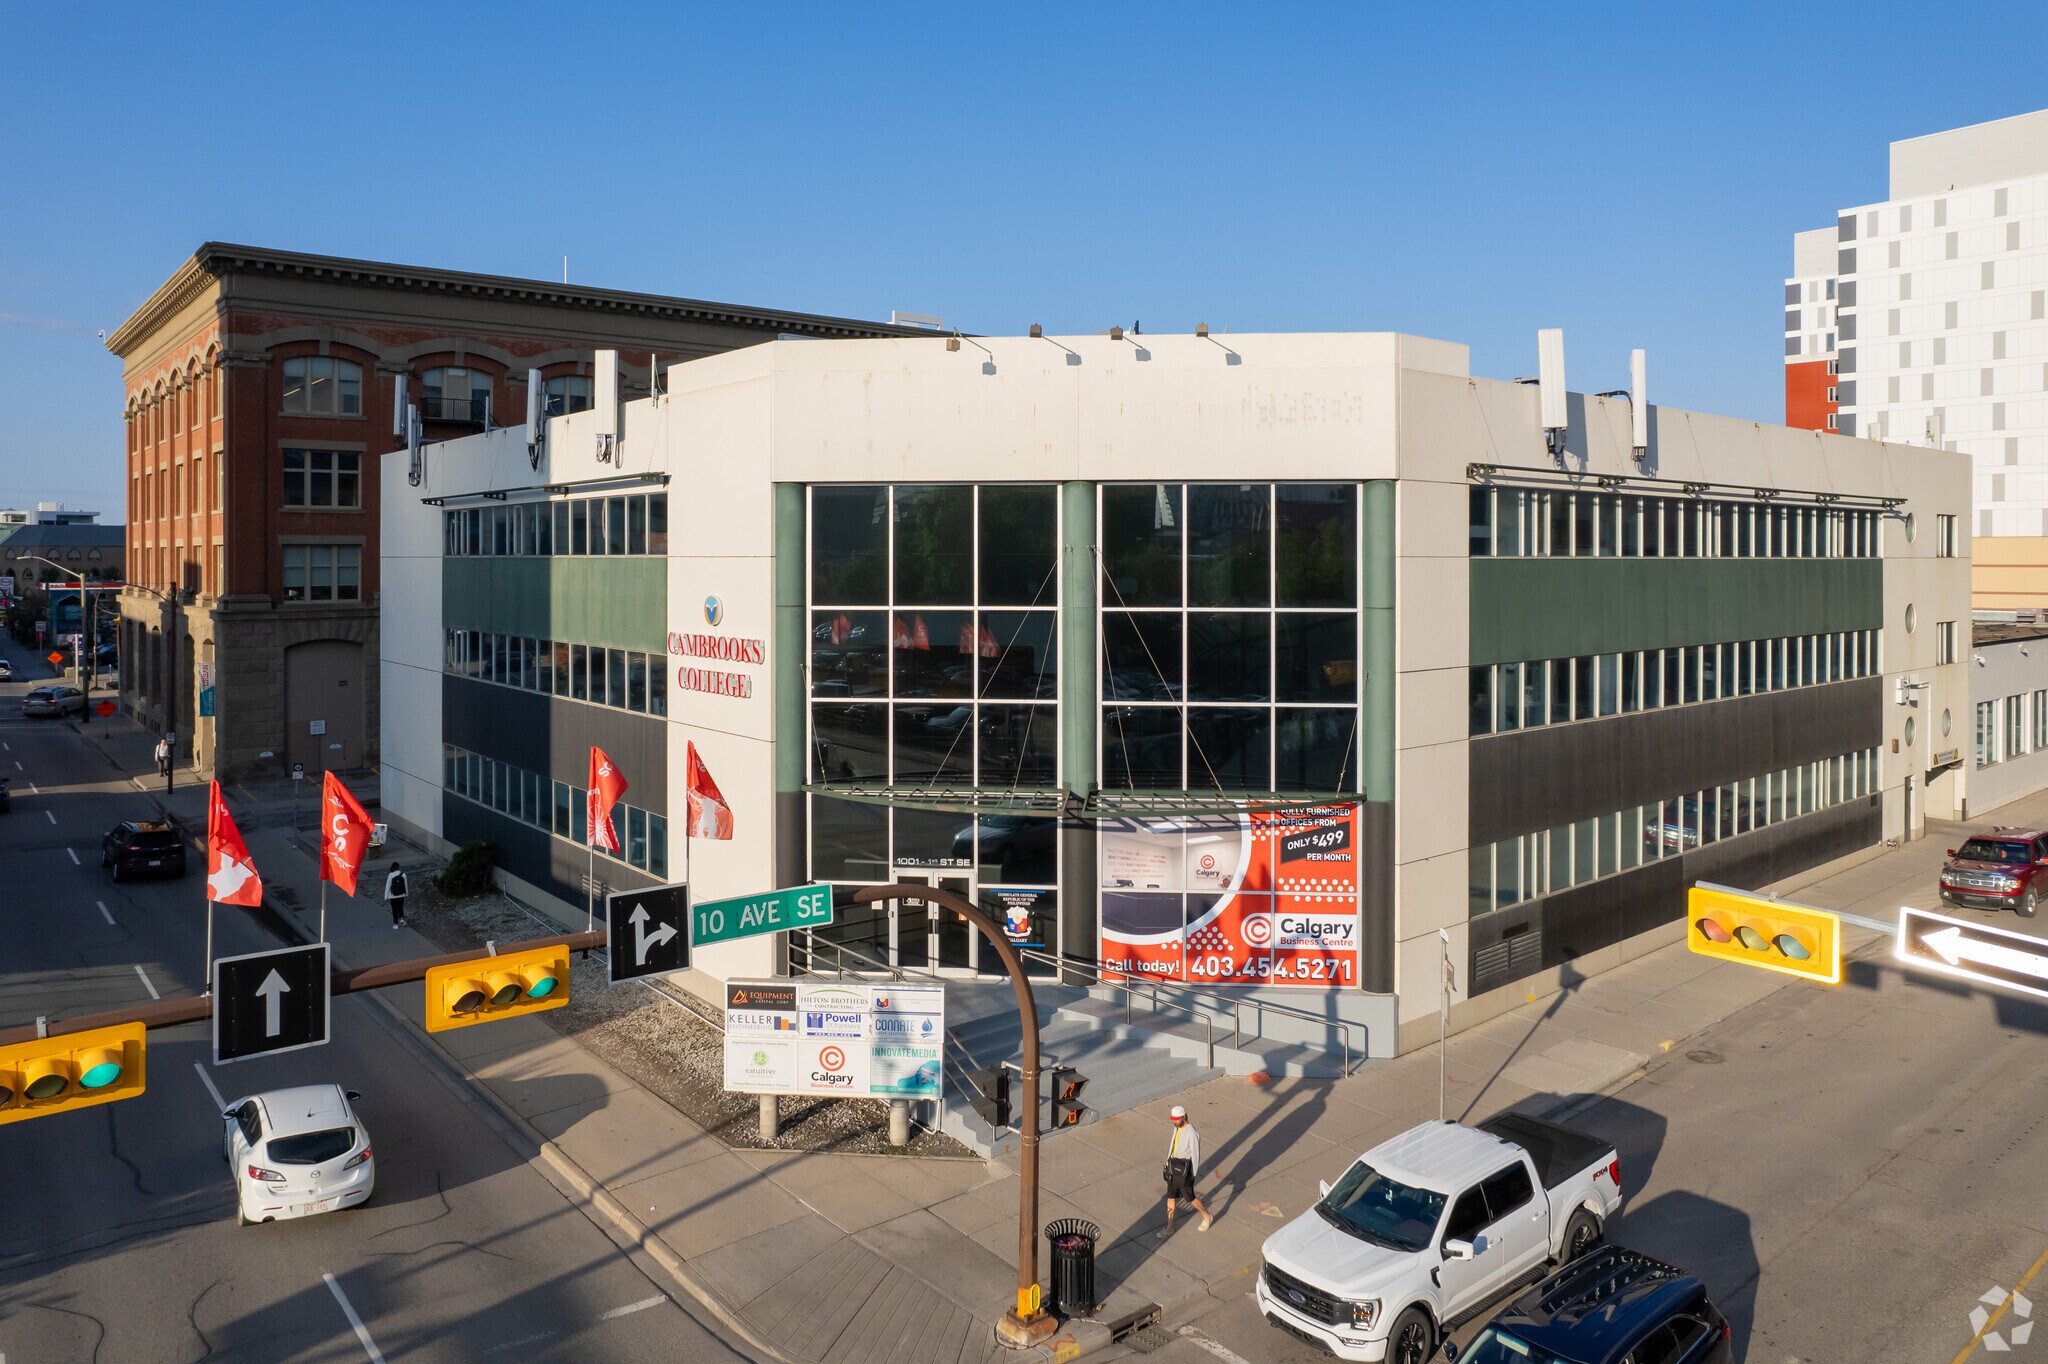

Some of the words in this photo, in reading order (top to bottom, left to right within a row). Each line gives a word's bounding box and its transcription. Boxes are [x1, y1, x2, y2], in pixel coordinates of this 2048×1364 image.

[667, 632, 765, 665] CAMBROOKS
[678, 667, 751, 698] COLLEGE
[1306, 807, 1351, 817] FURNISHED
[1280, 817, 1313, 826] OFFICES
[1314, 818, 1337, 827] FROM
[1287, 837, 1311, 850] ONLY
[1312, 830, 1344, 848] $499
[896, 857, 920, 866] 1001
[940, 858, 954, 866] ST
[956, 858, 971, 867] SE
[1306, 853, 1322, 861] PER
[1323, 853, 1351, 862] MONTH
[1195, 869, 1220, 877] Calgary
[700, 909, 725, 936] 10
[739, 899, 781, 929] AVE
[797, 893, 826, 919] SE
[1280, 918, 1354, 938] Calgary
[1280, 936, 1319, 946] Business
[1322, 937, 1354, 947] Centre
[1105, 958, 1133, 972] Call
[1137, 958, 1180, 975] today!
[1191, 955, 1352, 980] 403.454.5271
[749, 991, 795, 1000] EQUIPMENT
[800, 996, 829, 1004] HILTON
[830, 997, 869, 1005] BROTHERS
[729, 1014, 773, 1025] KELLER
[825, 1013, 862, 1023] Powell
[871, 1046, 937, 1059] INNOVATEMEDIA
[811, 1071, 854, 1085] Calgary
